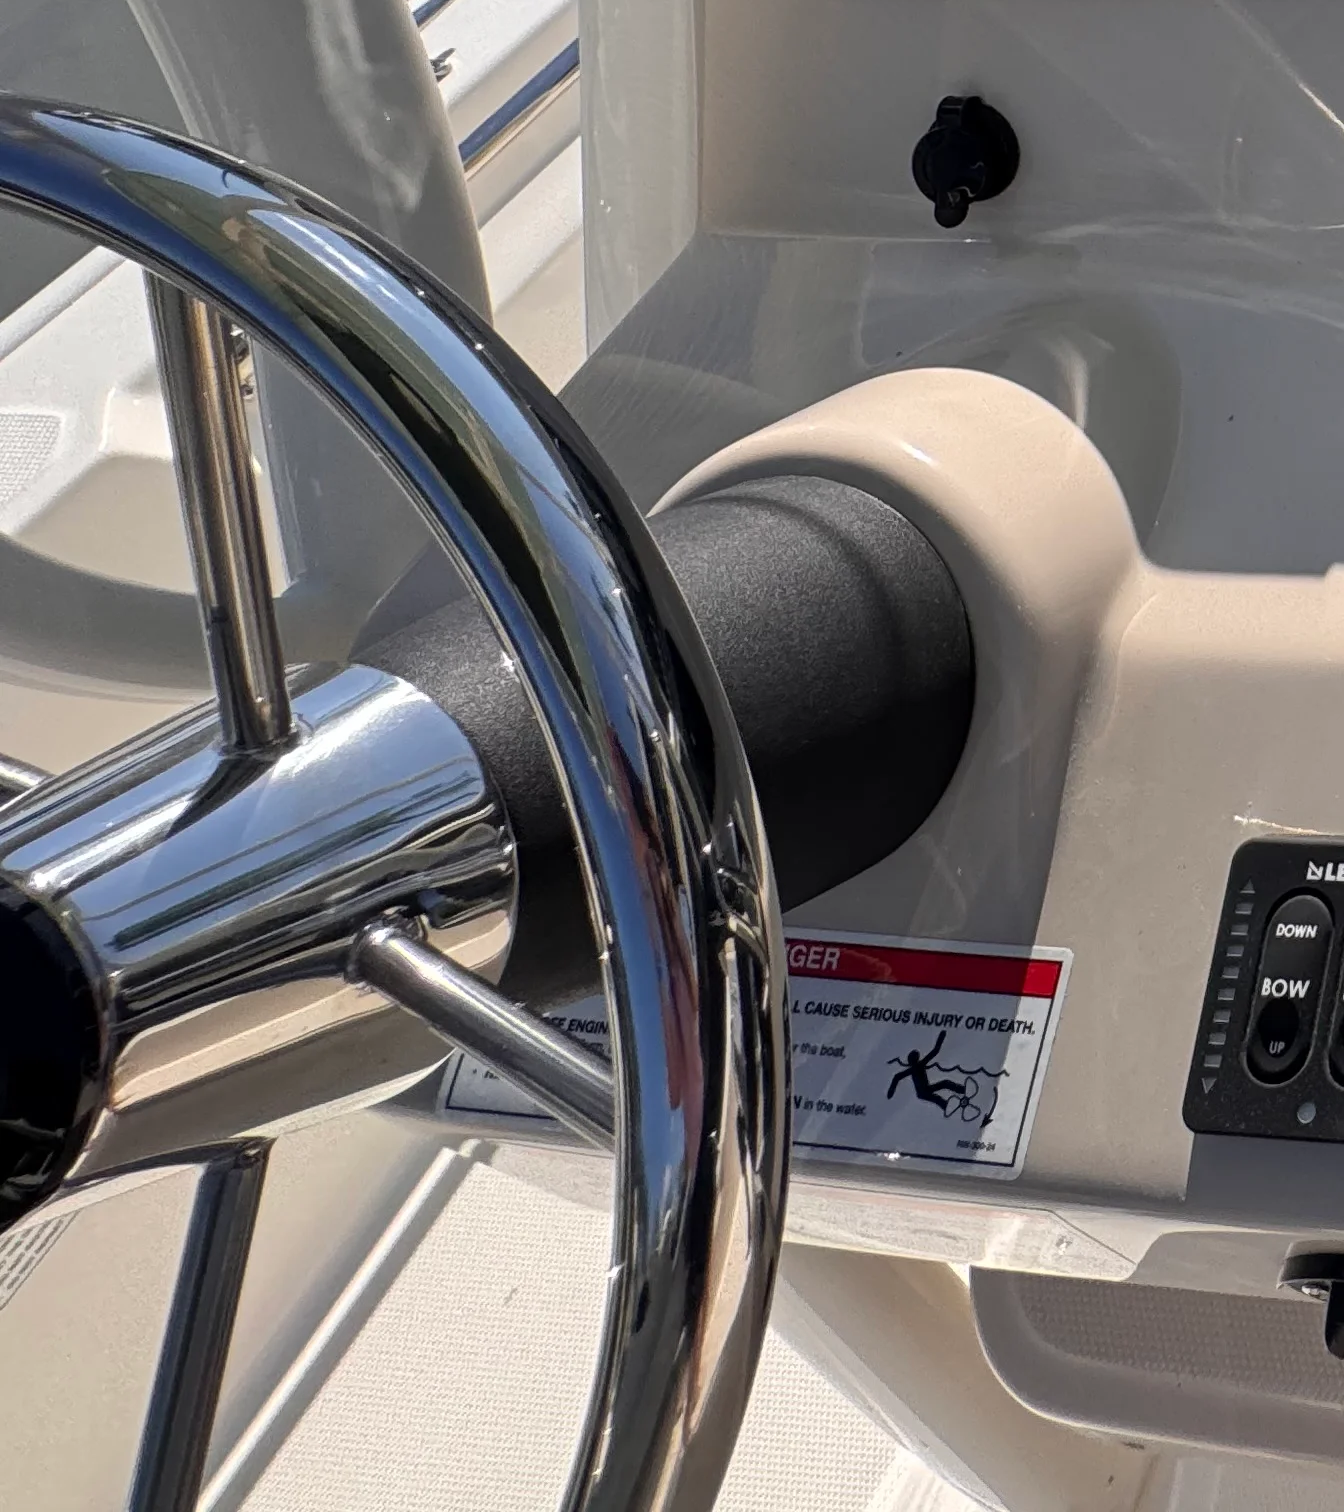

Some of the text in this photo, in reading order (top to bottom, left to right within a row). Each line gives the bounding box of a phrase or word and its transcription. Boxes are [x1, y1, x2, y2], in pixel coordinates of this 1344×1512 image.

[1275, 923, 1318, 938] DOWN
[785, 944, 841, 971] GER
[1261, 978, 1311, 999] BOW
[804, 1000, 851, 1018] CAUSE
[852, 1006, 911, 1025] SERIOUS
[913, 1010, 964, 1029] INJURY
[965, 1016, 985, 1030] OR
[988, 1019, 1036, 1035] DEATH.
[567, 1018, 610, 1034] ENGIN
[1269, 1041, 1285, 1054] UP
[816, 1097, 834, 1113] the
